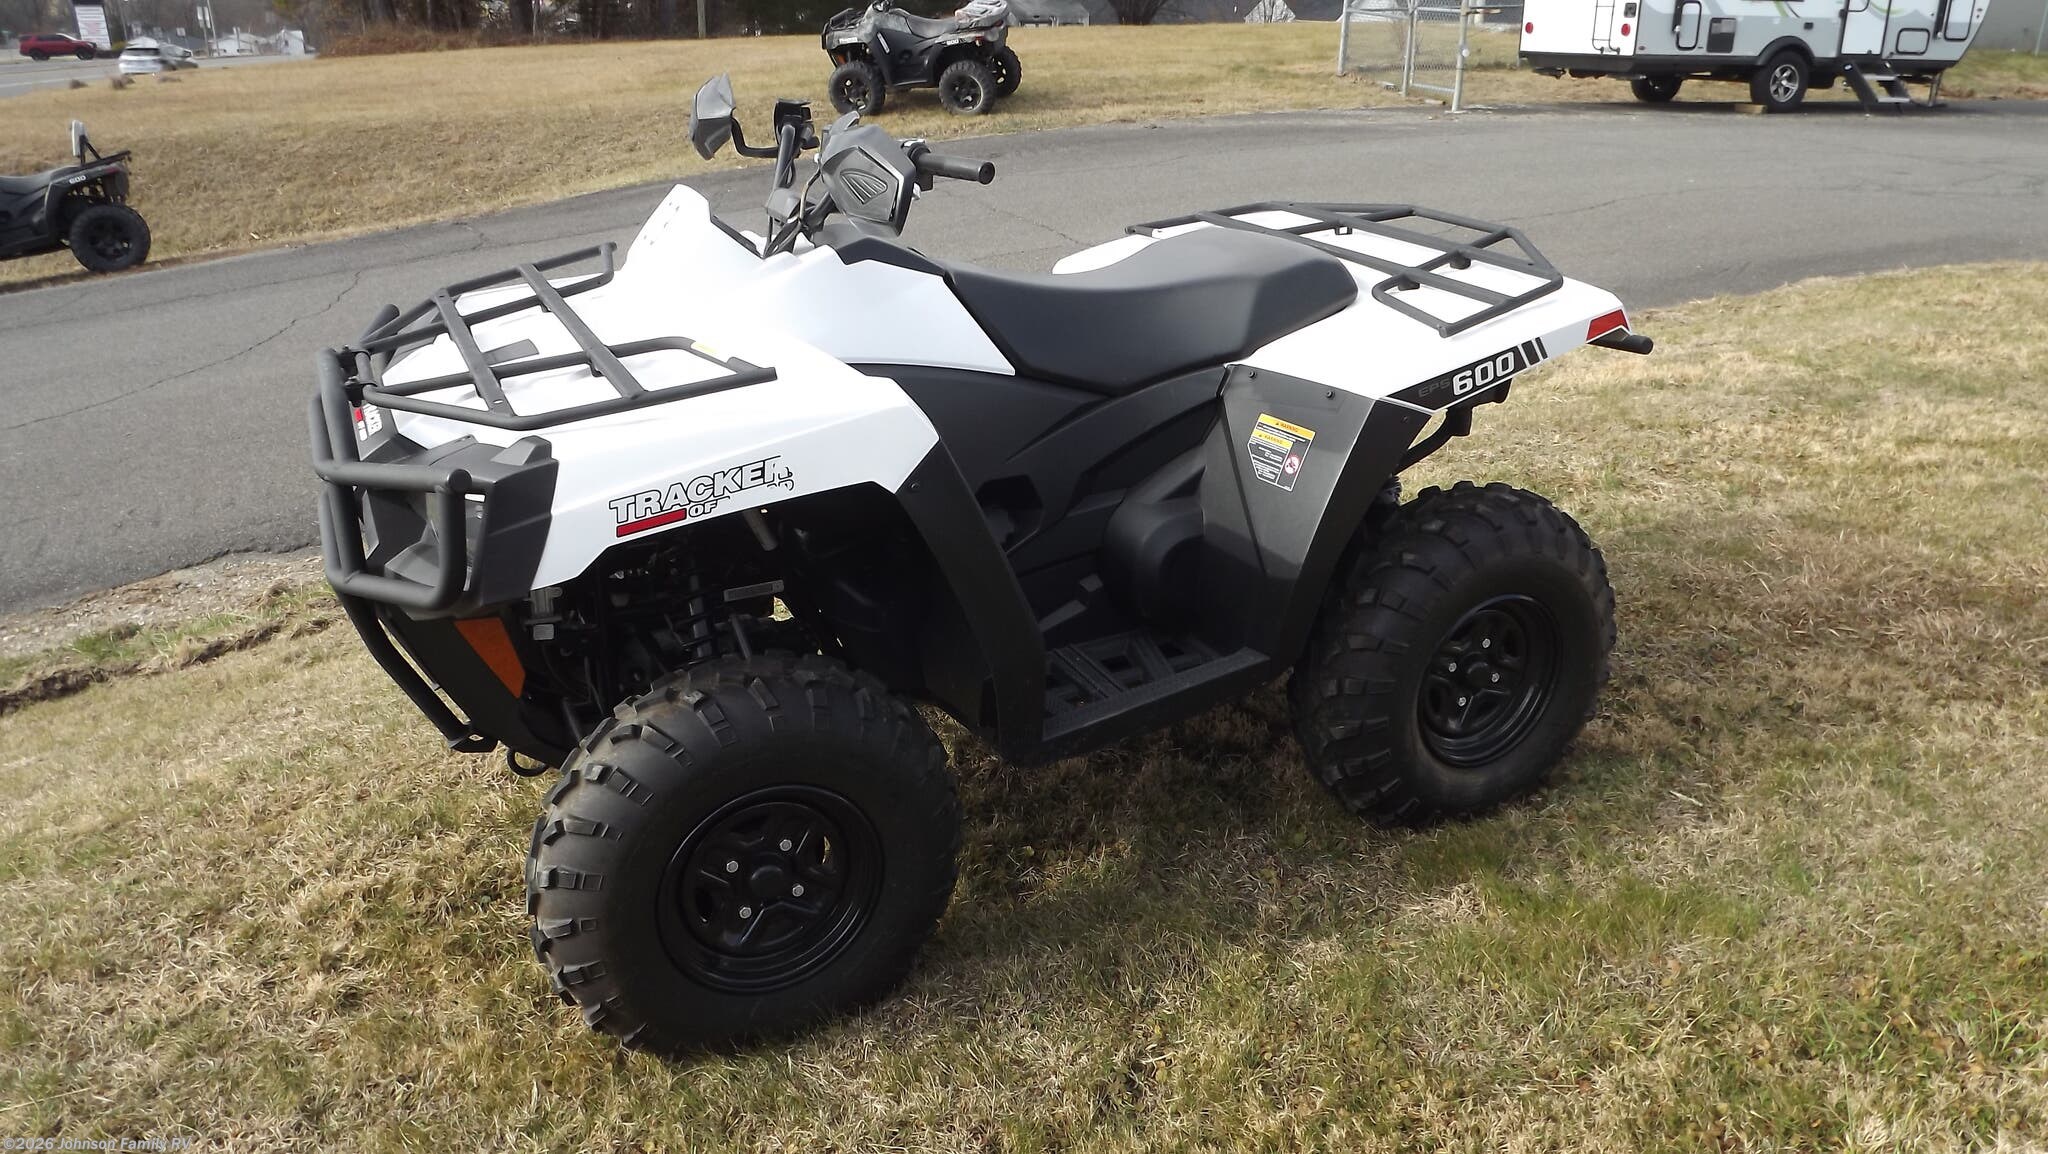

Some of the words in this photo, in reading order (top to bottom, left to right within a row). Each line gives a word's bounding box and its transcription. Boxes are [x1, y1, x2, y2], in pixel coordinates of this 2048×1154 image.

[1418, 378, 1451, 398] EPS
[1452, 351, 1515, 396] 600
[609, 455, 793, 524] TRACKER
